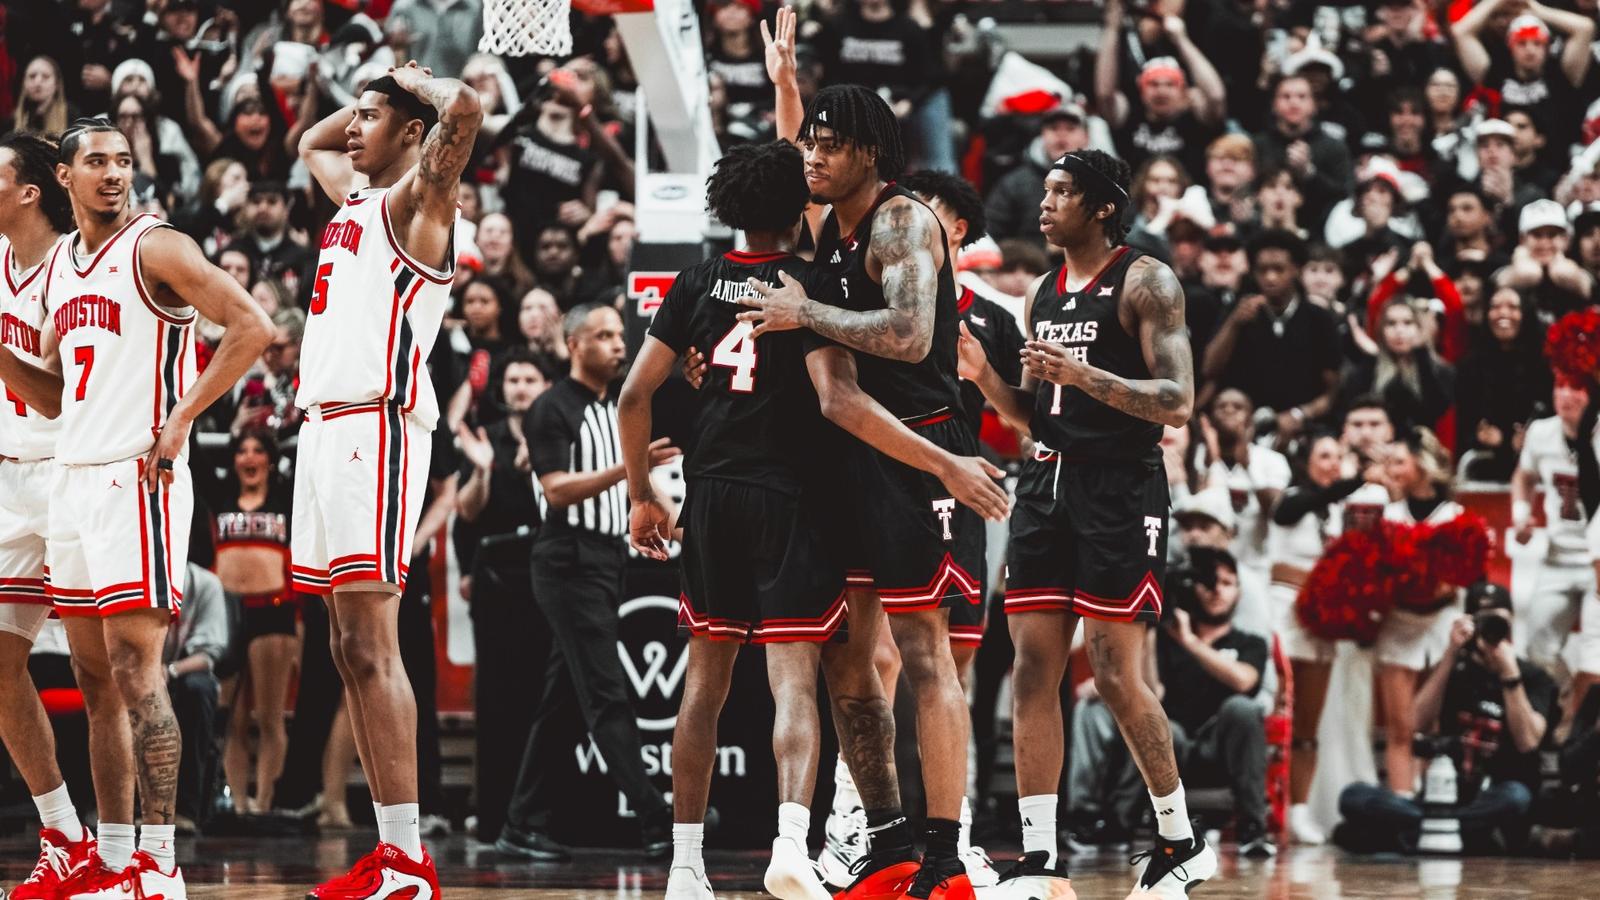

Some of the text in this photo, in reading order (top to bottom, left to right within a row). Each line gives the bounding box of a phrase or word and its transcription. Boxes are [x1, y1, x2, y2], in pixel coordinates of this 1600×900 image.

[311, 262, 334, 316] 5
[54, 294, 121, 341] HOUSTON
[1036, 320, 1098, 343] TEXAS
[74, 345, 95, 402] 7
[711, 319, 757, 393] 4
[575, 732, 747, 777] Wstn
